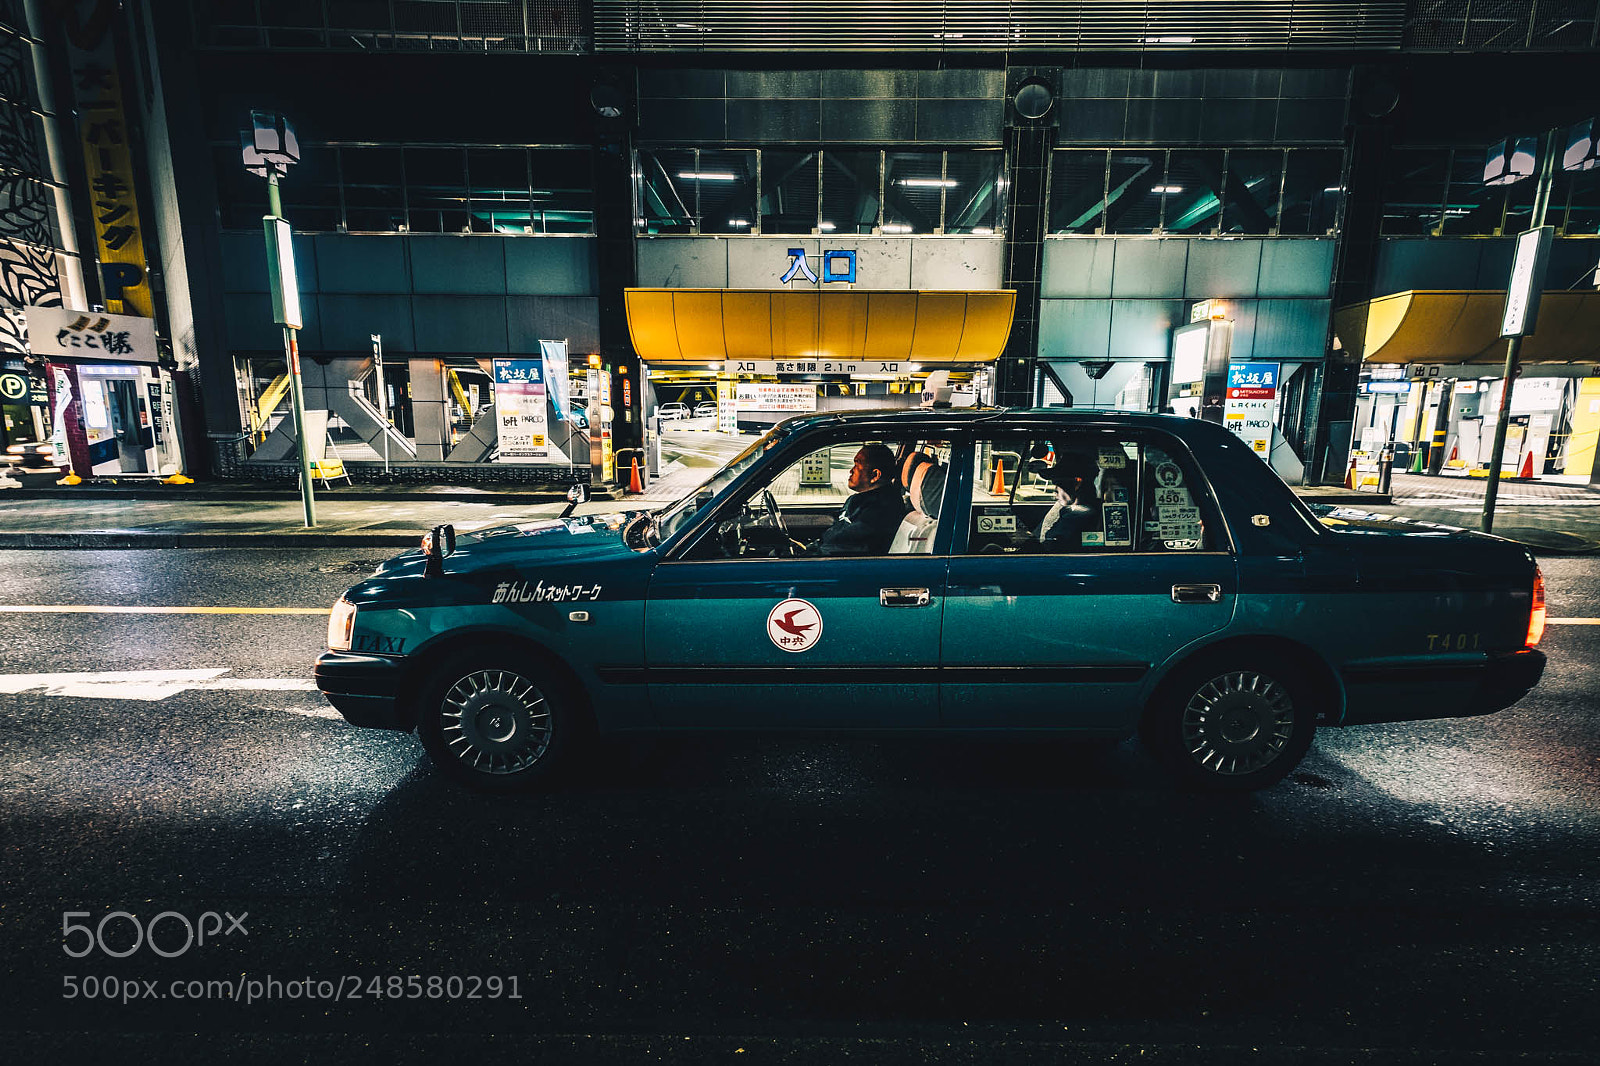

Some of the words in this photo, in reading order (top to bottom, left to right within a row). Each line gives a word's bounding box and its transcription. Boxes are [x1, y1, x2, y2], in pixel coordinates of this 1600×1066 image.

[780, 248, 856, 284] 入口
[500, 367, 540, 381] 松坂屋
[737, 362, 755, 372] 入口
[776, 362, 817, 372] 高さ制限
[824, 363, 856, 372] 2.1m
[880, 362, 898, 372] 入口
[1415, 366, 1439, 377] 出口
[1232, 370, 1273, 385] 松坂屋
[521, 415, 544, 424] PARCO
[1246, 420, 1270, 428] PARCO
[492, 580, 602, 603] あんしんネットワーク
[356, 635, 407, 652] TAXI
[780, 636, 805, 646] 中央
[1427, 633, 1480, 651] T401
